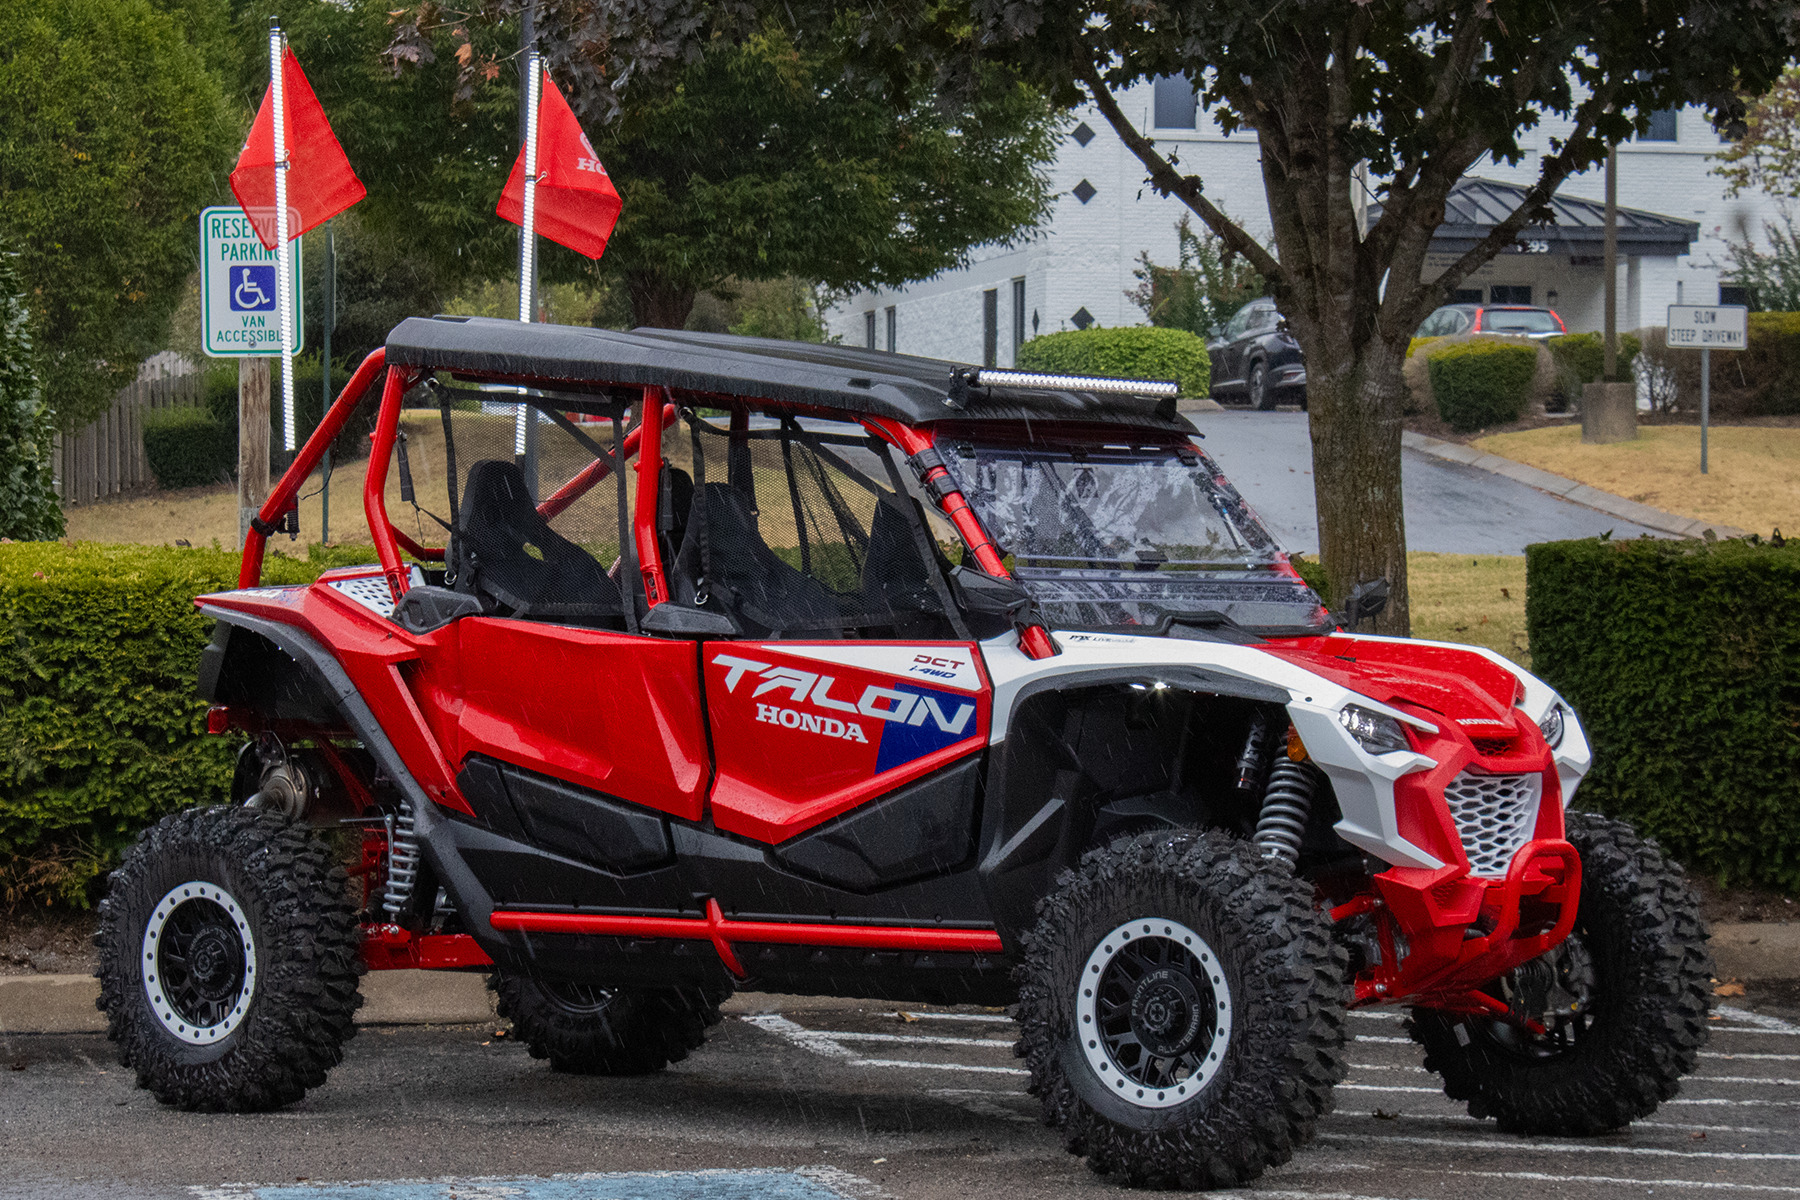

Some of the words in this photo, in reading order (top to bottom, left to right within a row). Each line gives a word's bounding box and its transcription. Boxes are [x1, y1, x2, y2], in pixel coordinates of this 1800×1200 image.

[212, 218, 289, 238] RESERVE
[242, 316, 265, 327] VAN
[1694, 311, 1716, 324] SLOW
[217, 330, 284, 342] ACCESSIBL
[1671, 328, 1696, 342] STEEP
[1702, 329, 1743, 343] DRIVEWAY
[913, 654, 965, 669] DCT
[712, 654, 975, 735] TALON
[756, 702, 869, 744] HONDA
[1455, 718, 1504, 726] HONDA
[1131, 970, 1169, 1016] FRONTLINE
[1157, 1004, 1199, 1054] ALL-TERRAIN
